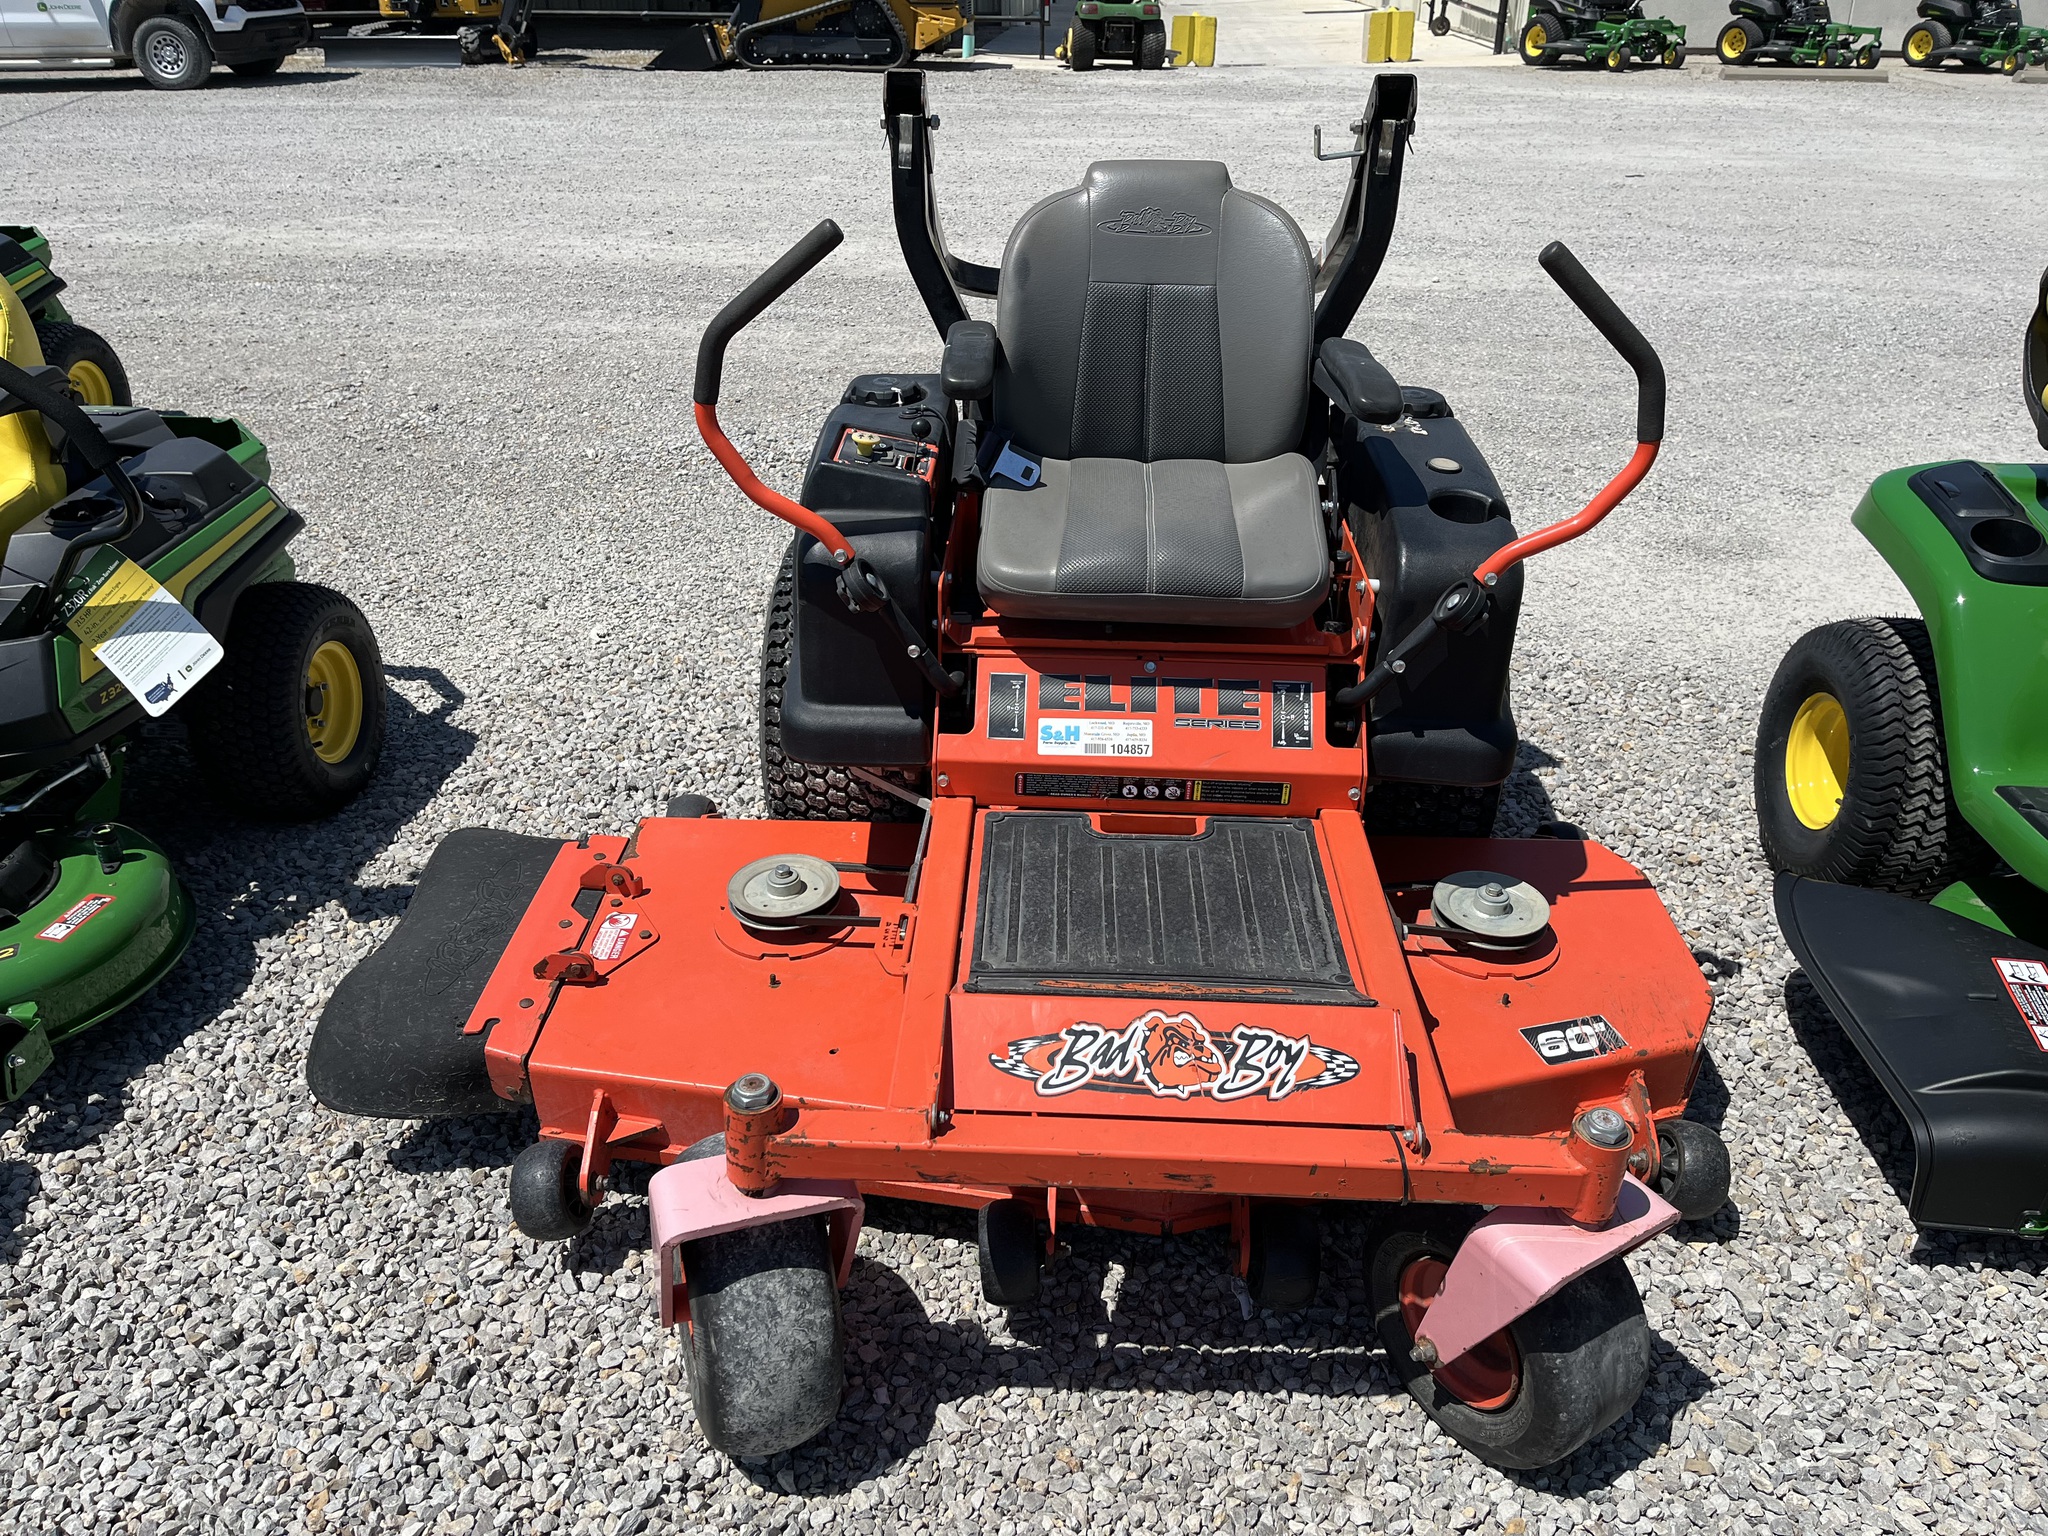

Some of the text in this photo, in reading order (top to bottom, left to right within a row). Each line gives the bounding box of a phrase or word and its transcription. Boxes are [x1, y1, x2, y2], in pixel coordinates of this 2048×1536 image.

[61, 589, 89, 617] Z320R
[74, 615, 85, 627] 21.5
[82, 608, 93, 618] HP
[82, 619, 98, 635] 42-in.
[91, 627, 108, 644] 3-Year
[199, 646, 211, 658] DEERE
[1038, 674, 1260, 716] ELITE
[1040, 724, 1080, 741] S&H
[1174, 717, 1261, 731] SERIES
[1110, 744, 1150, 755] 104857
[1038, 1022, 1311, 1101] Bad Boy
